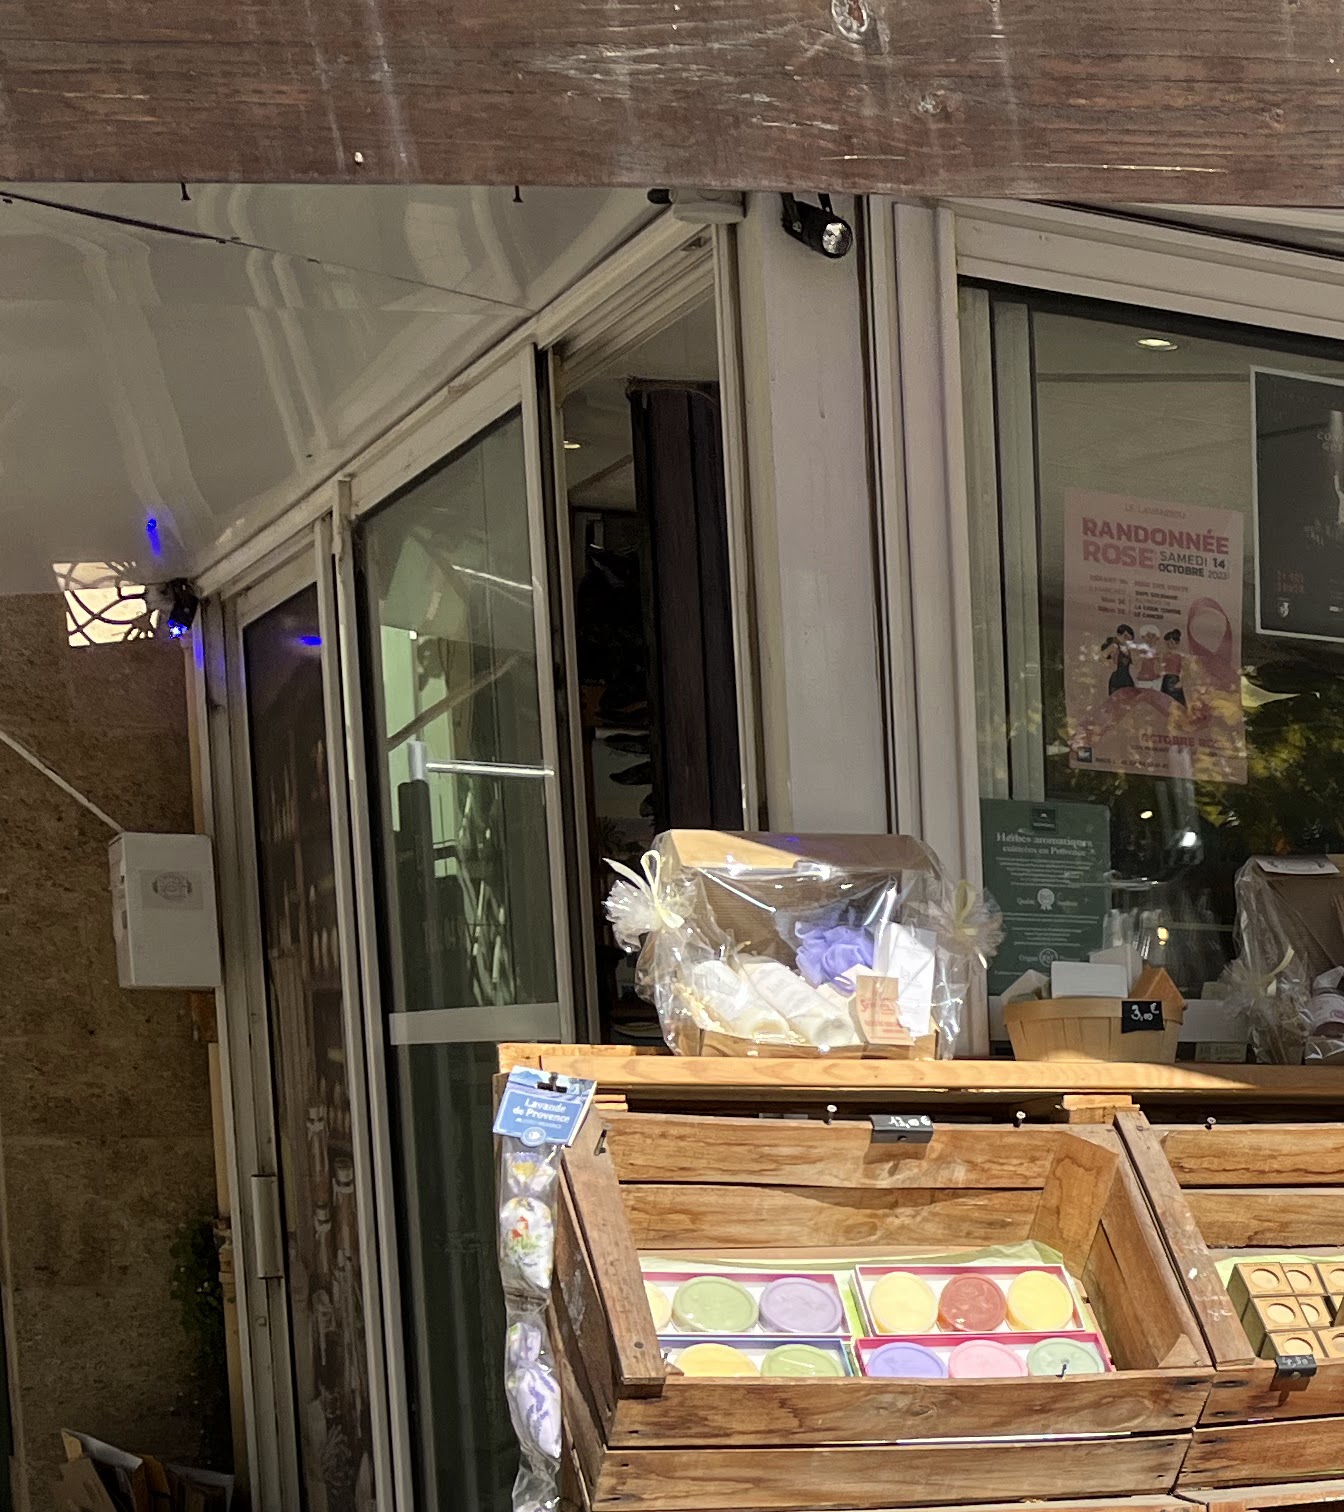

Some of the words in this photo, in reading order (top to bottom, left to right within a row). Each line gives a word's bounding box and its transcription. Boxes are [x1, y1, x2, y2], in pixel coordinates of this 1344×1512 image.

[1082, 517, 1229, 555] RANDONNÉE
[1083, 540, 1154, 569] ROSE
[1160, 551, 1208, 568] SAMEDI
[1213, 557, 1225, 569] 14
[1158, 563, 1204, 578] OCTOBRE
[512, 1105, 525, 1116] de
[525, 1107, 571, 1123] Provence
[524, 1098, 566, 1113] Lavande
